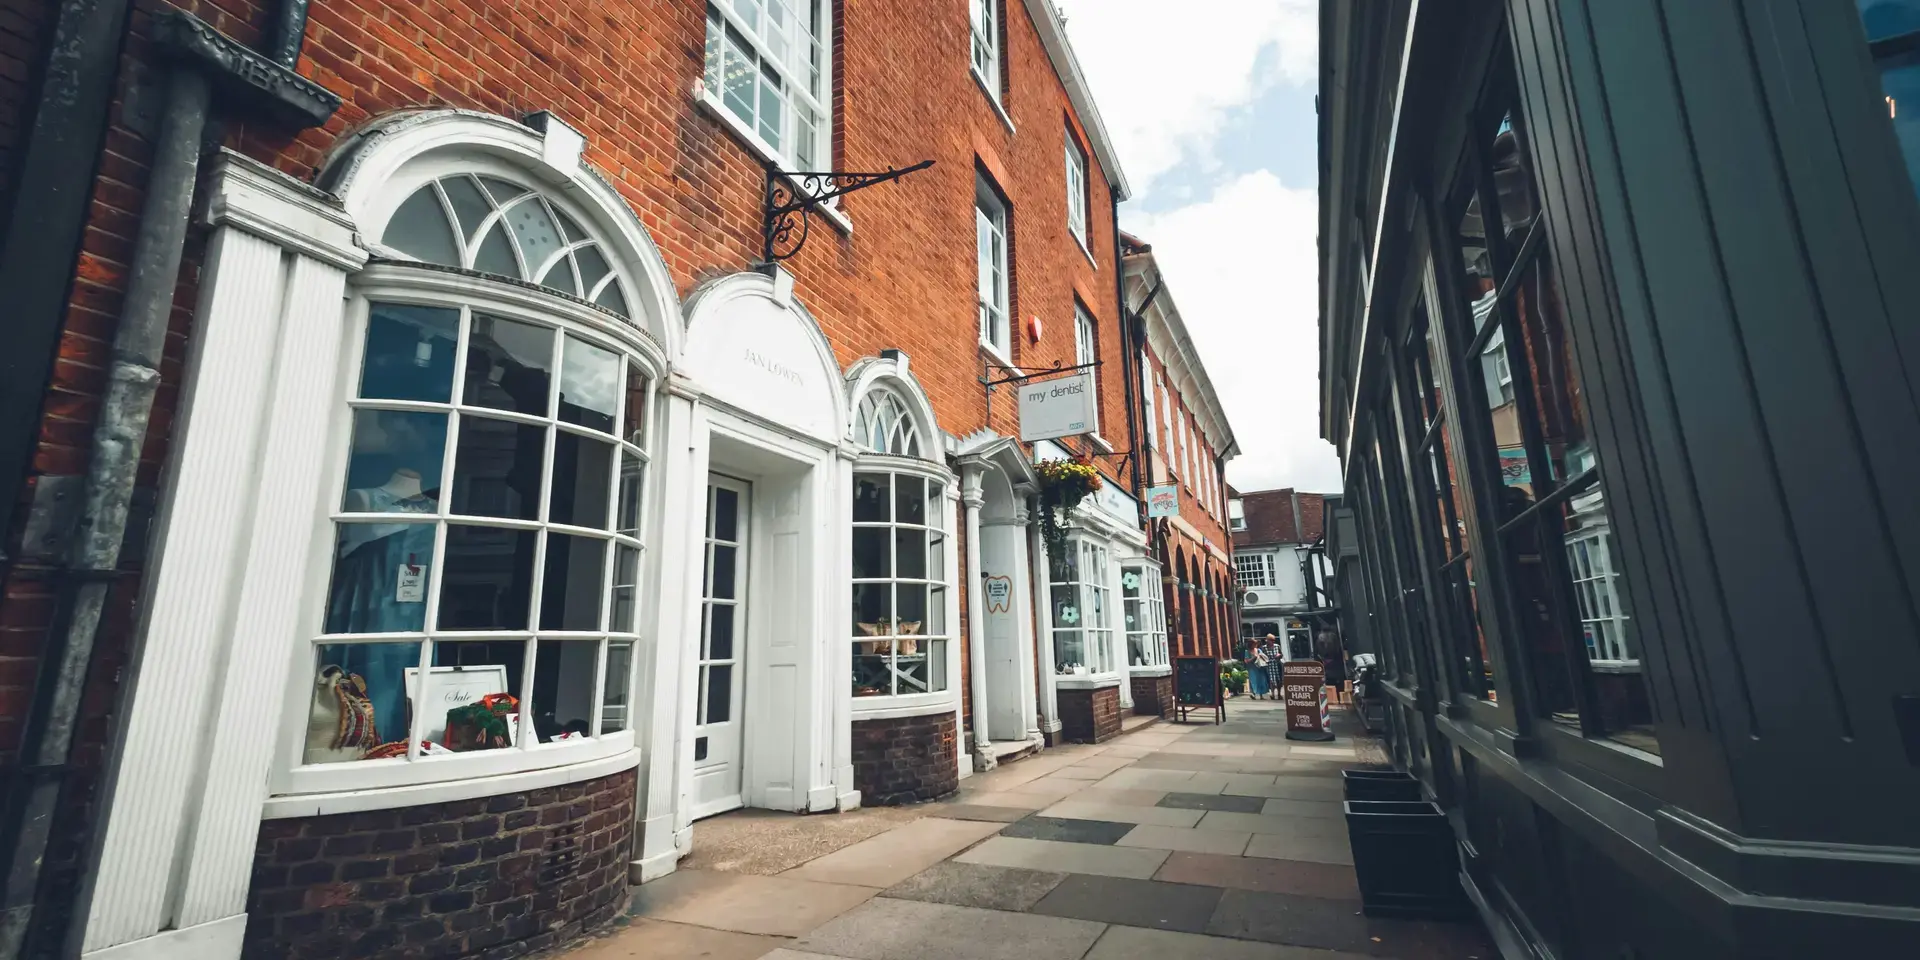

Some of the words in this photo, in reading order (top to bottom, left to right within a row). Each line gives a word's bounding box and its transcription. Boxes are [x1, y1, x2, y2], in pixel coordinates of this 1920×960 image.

[744, 348, 766, 367] JAN
[1029, 392, 1046, 402] my
[1051, 382, 1084, 397] dentist
[1286, 666, 1307, 674] BARBER
[1308, 666, 1322, 674] SHOP
[444, 690, 472, 703] Sale
[1287, 699, 1316, 707] Dresser
